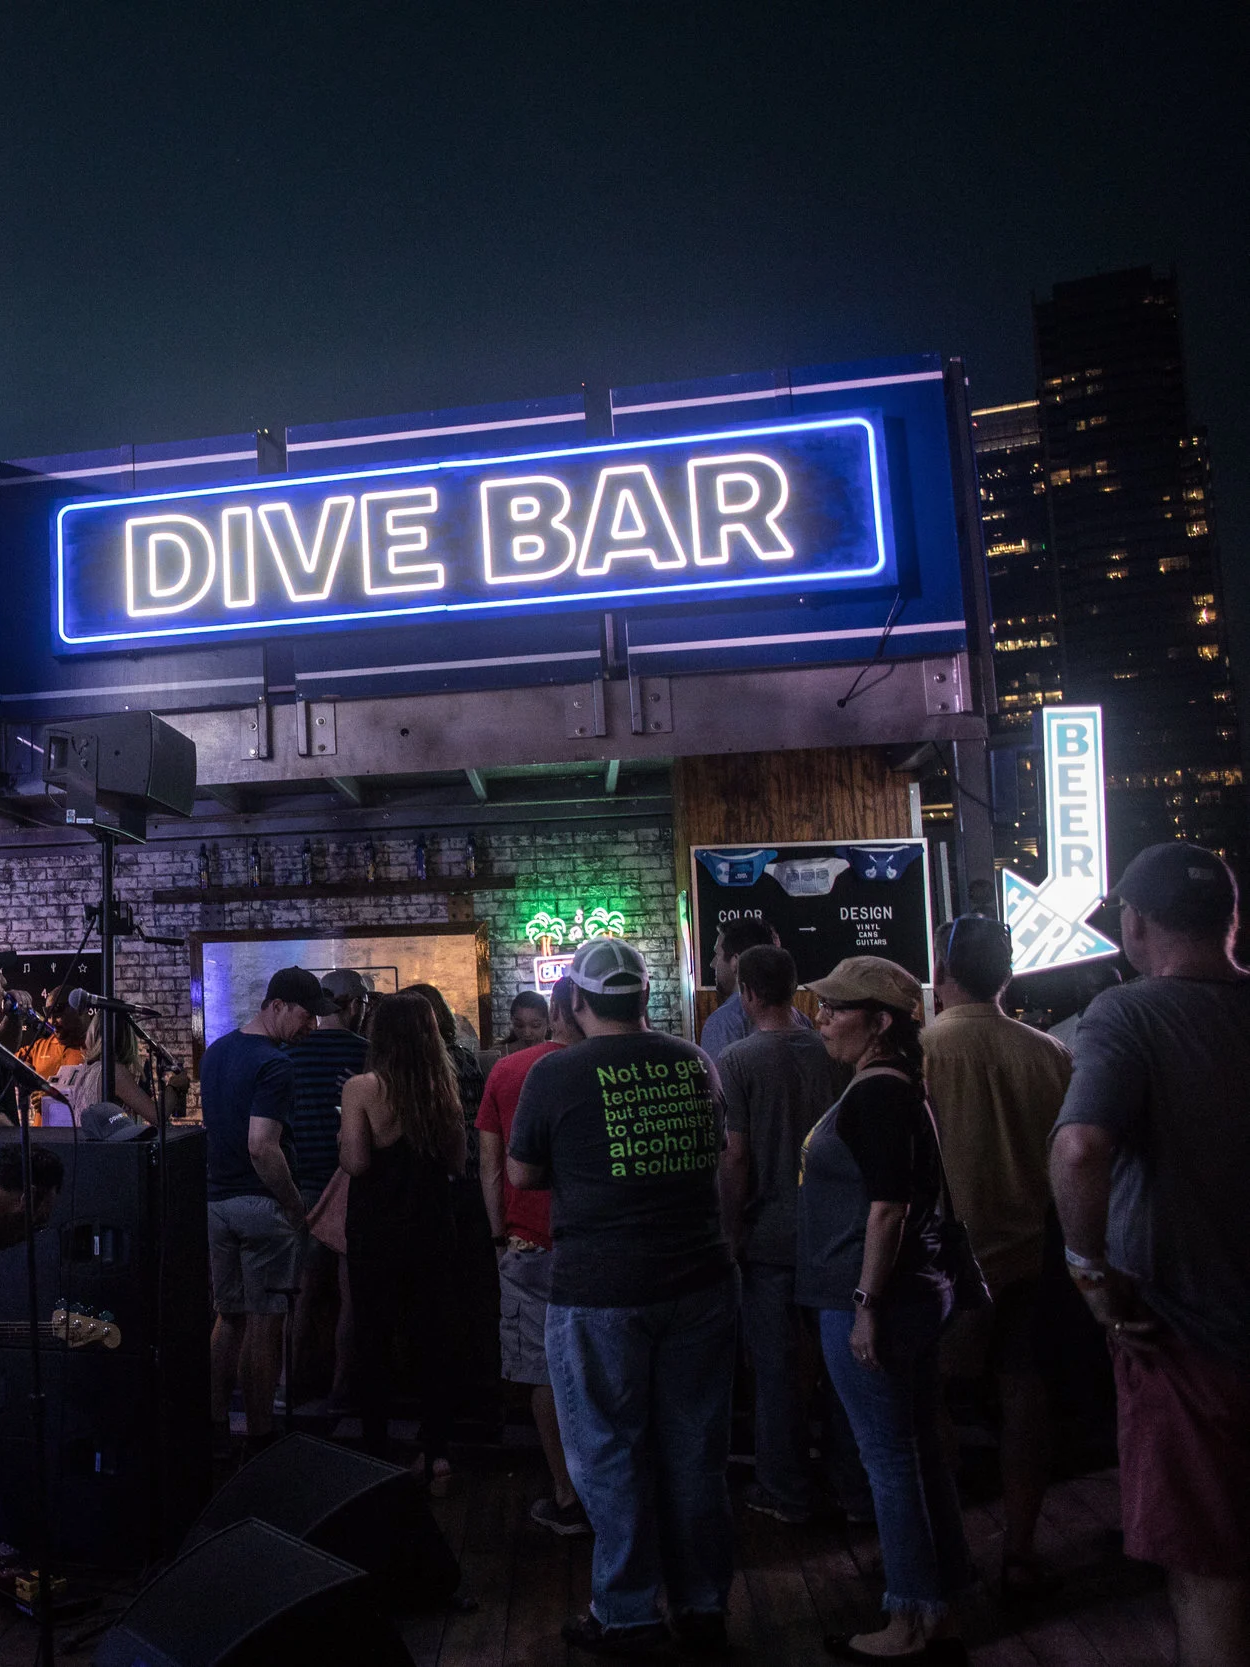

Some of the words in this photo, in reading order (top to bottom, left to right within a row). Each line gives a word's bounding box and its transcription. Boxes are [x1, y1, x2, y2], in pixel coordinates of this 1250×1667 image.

[124, 487, 445, 619] DIVE
[480, 453, 794, 586] BAR
[1056, 723, 1095, 877] BEER
[718, 908, 763, 923] COLOR
[840, 906, 893, 920] DESIGN
[1007, 887, 1097, 972] HERE
[596, 1063, 642, 1087] Not
[645, 1061, 668, 1079] to
[675, 1056, 708, 1080] get
[602, 1078, 710, 1106] technical...
[605, 1105, 635, 1122] but
[638, 1098, 713, 1117] according
[606, 1123, 627, 1138] to
[633, 1112, 715, 1135] chemistry
[610, 1129, 698, 1158] alcohol
[703, 1129, 716, 1147] is
[611, 1162, 627, 1177] a
[634, 1152, 717, 1176] solution
